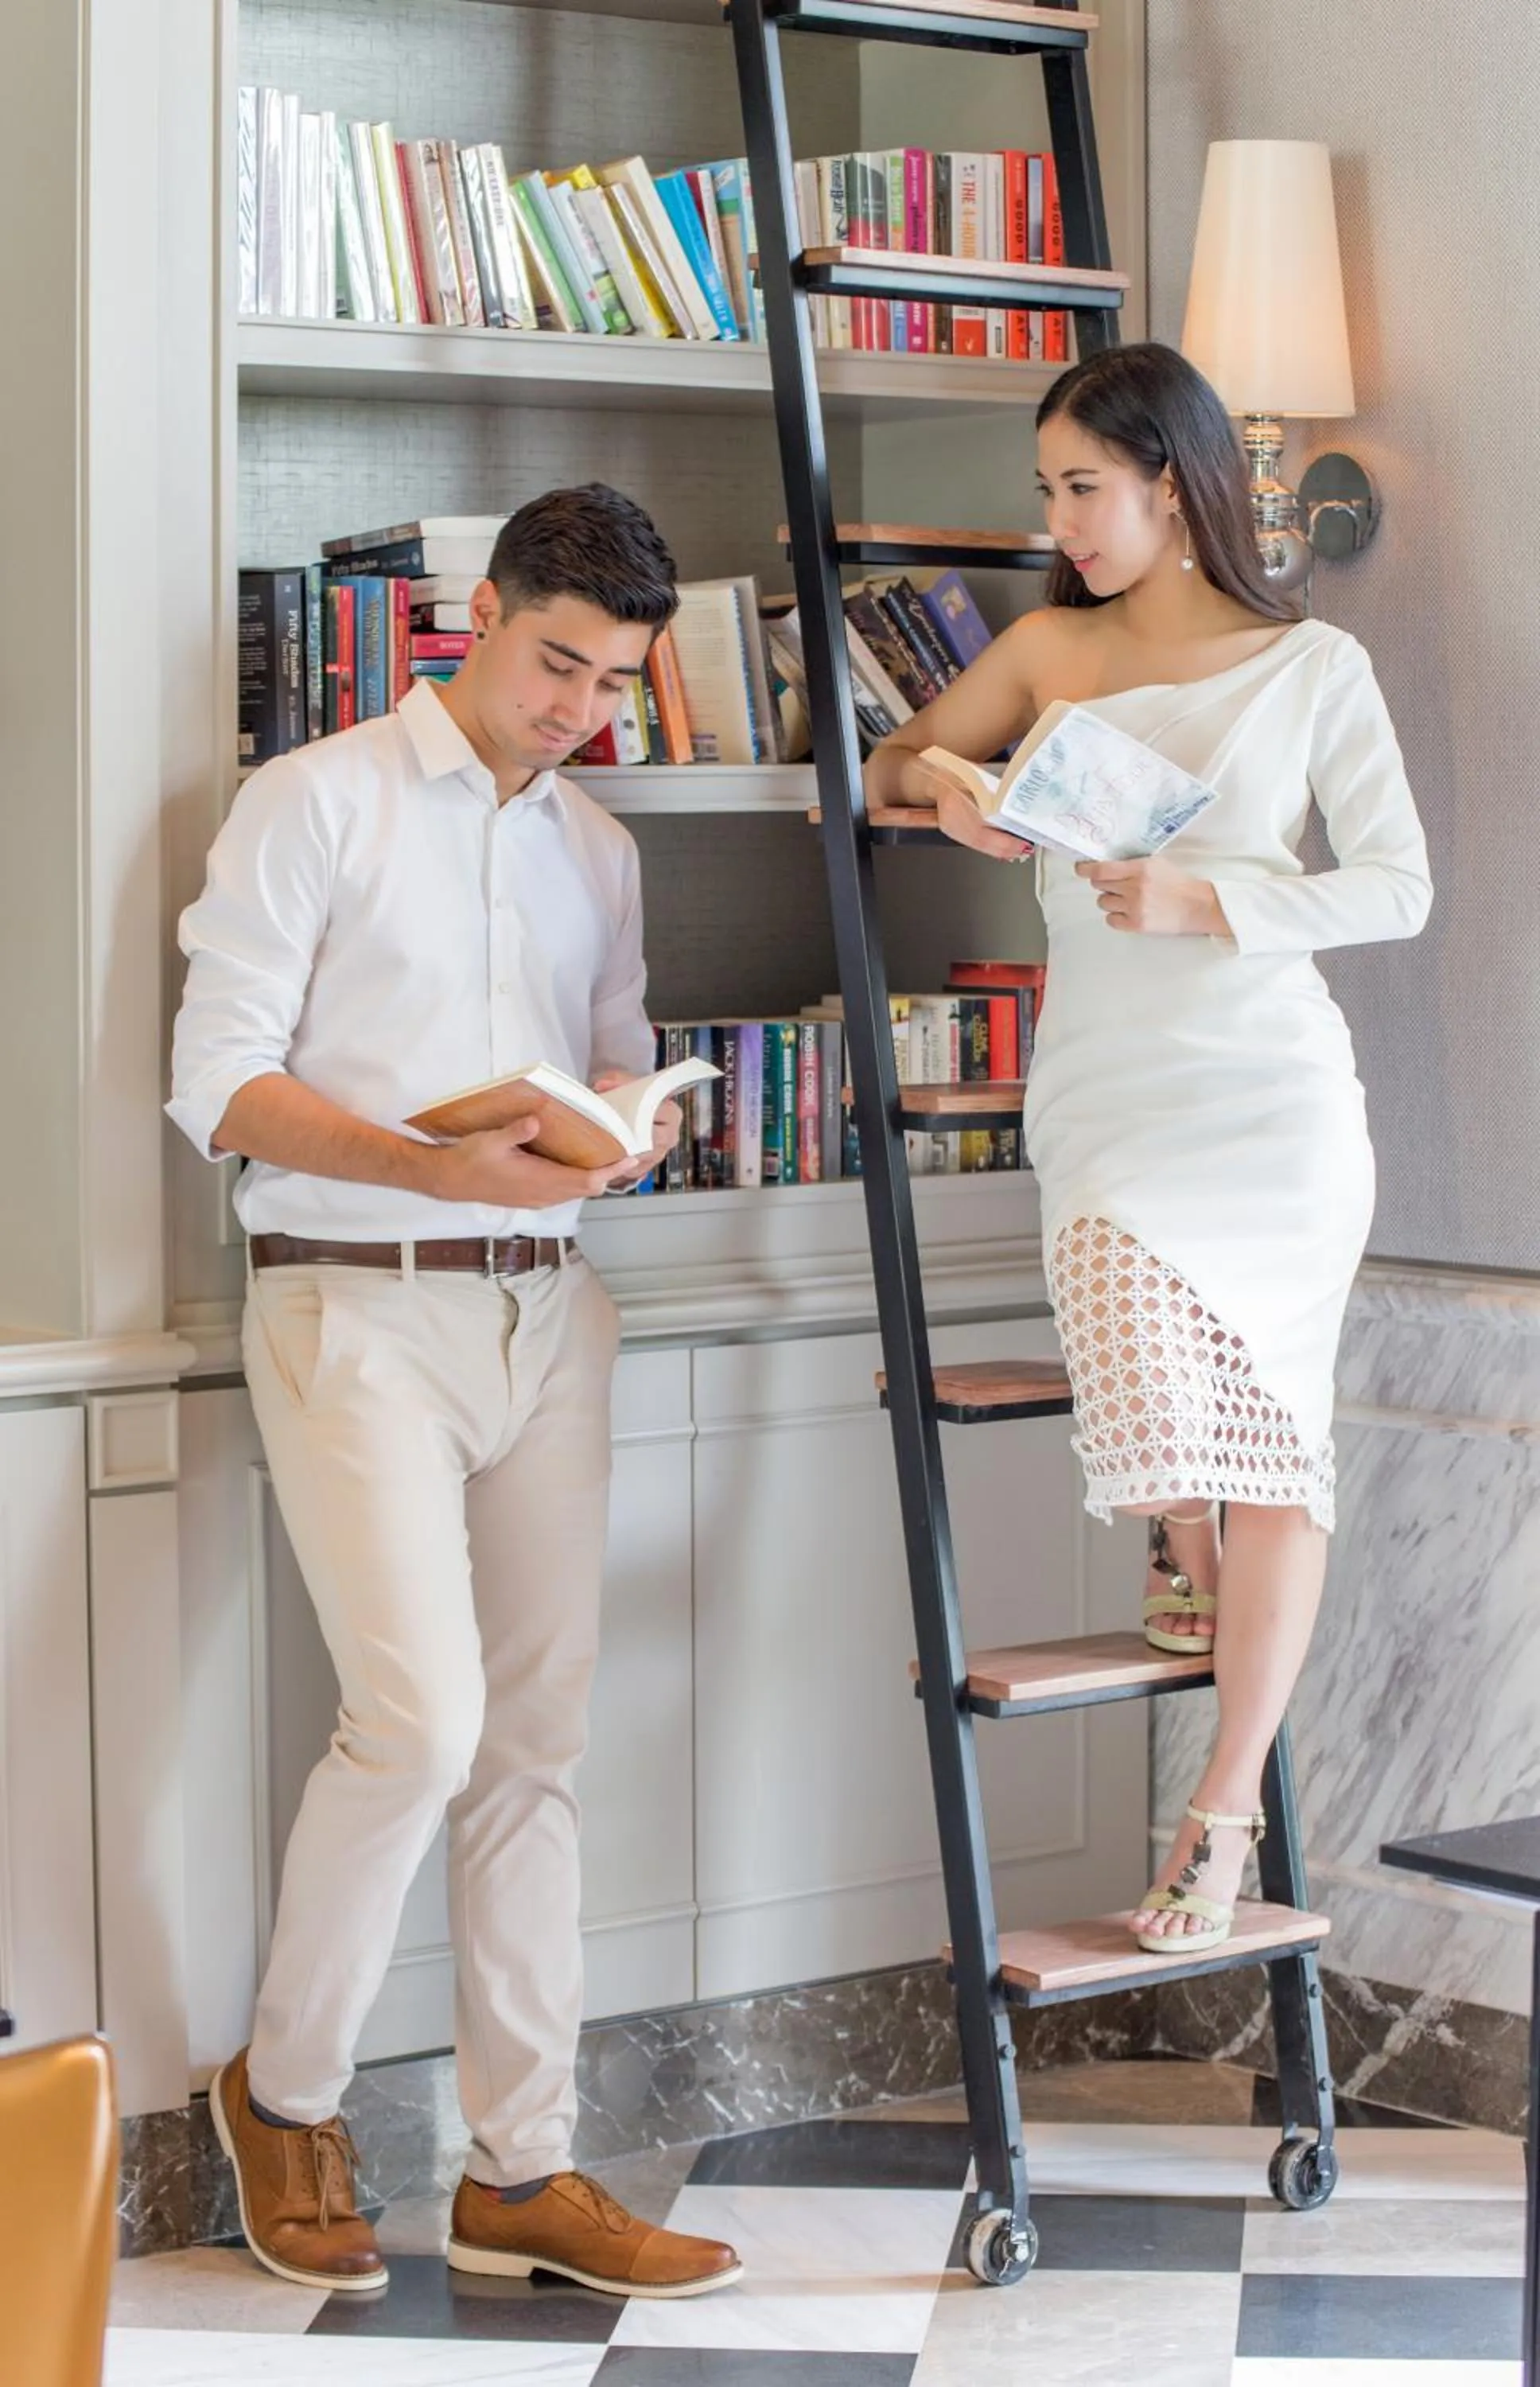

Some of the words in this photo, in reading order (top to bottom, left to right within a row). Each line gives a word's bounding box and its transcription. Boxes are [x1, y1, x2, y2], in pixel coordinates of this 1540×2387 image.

[961, 182, 976, 204] THE
[724, 1040, 735, 1073] JACK
[803, 1025, 815, 1067] ROBIN
[783, 1048, 792, 1082] ROBIN
[725, 1075, 735, 1125] HIGGINS
[783, 1084, 792, 1114] COOK
[804, 1071, 815, 1106] COOK
